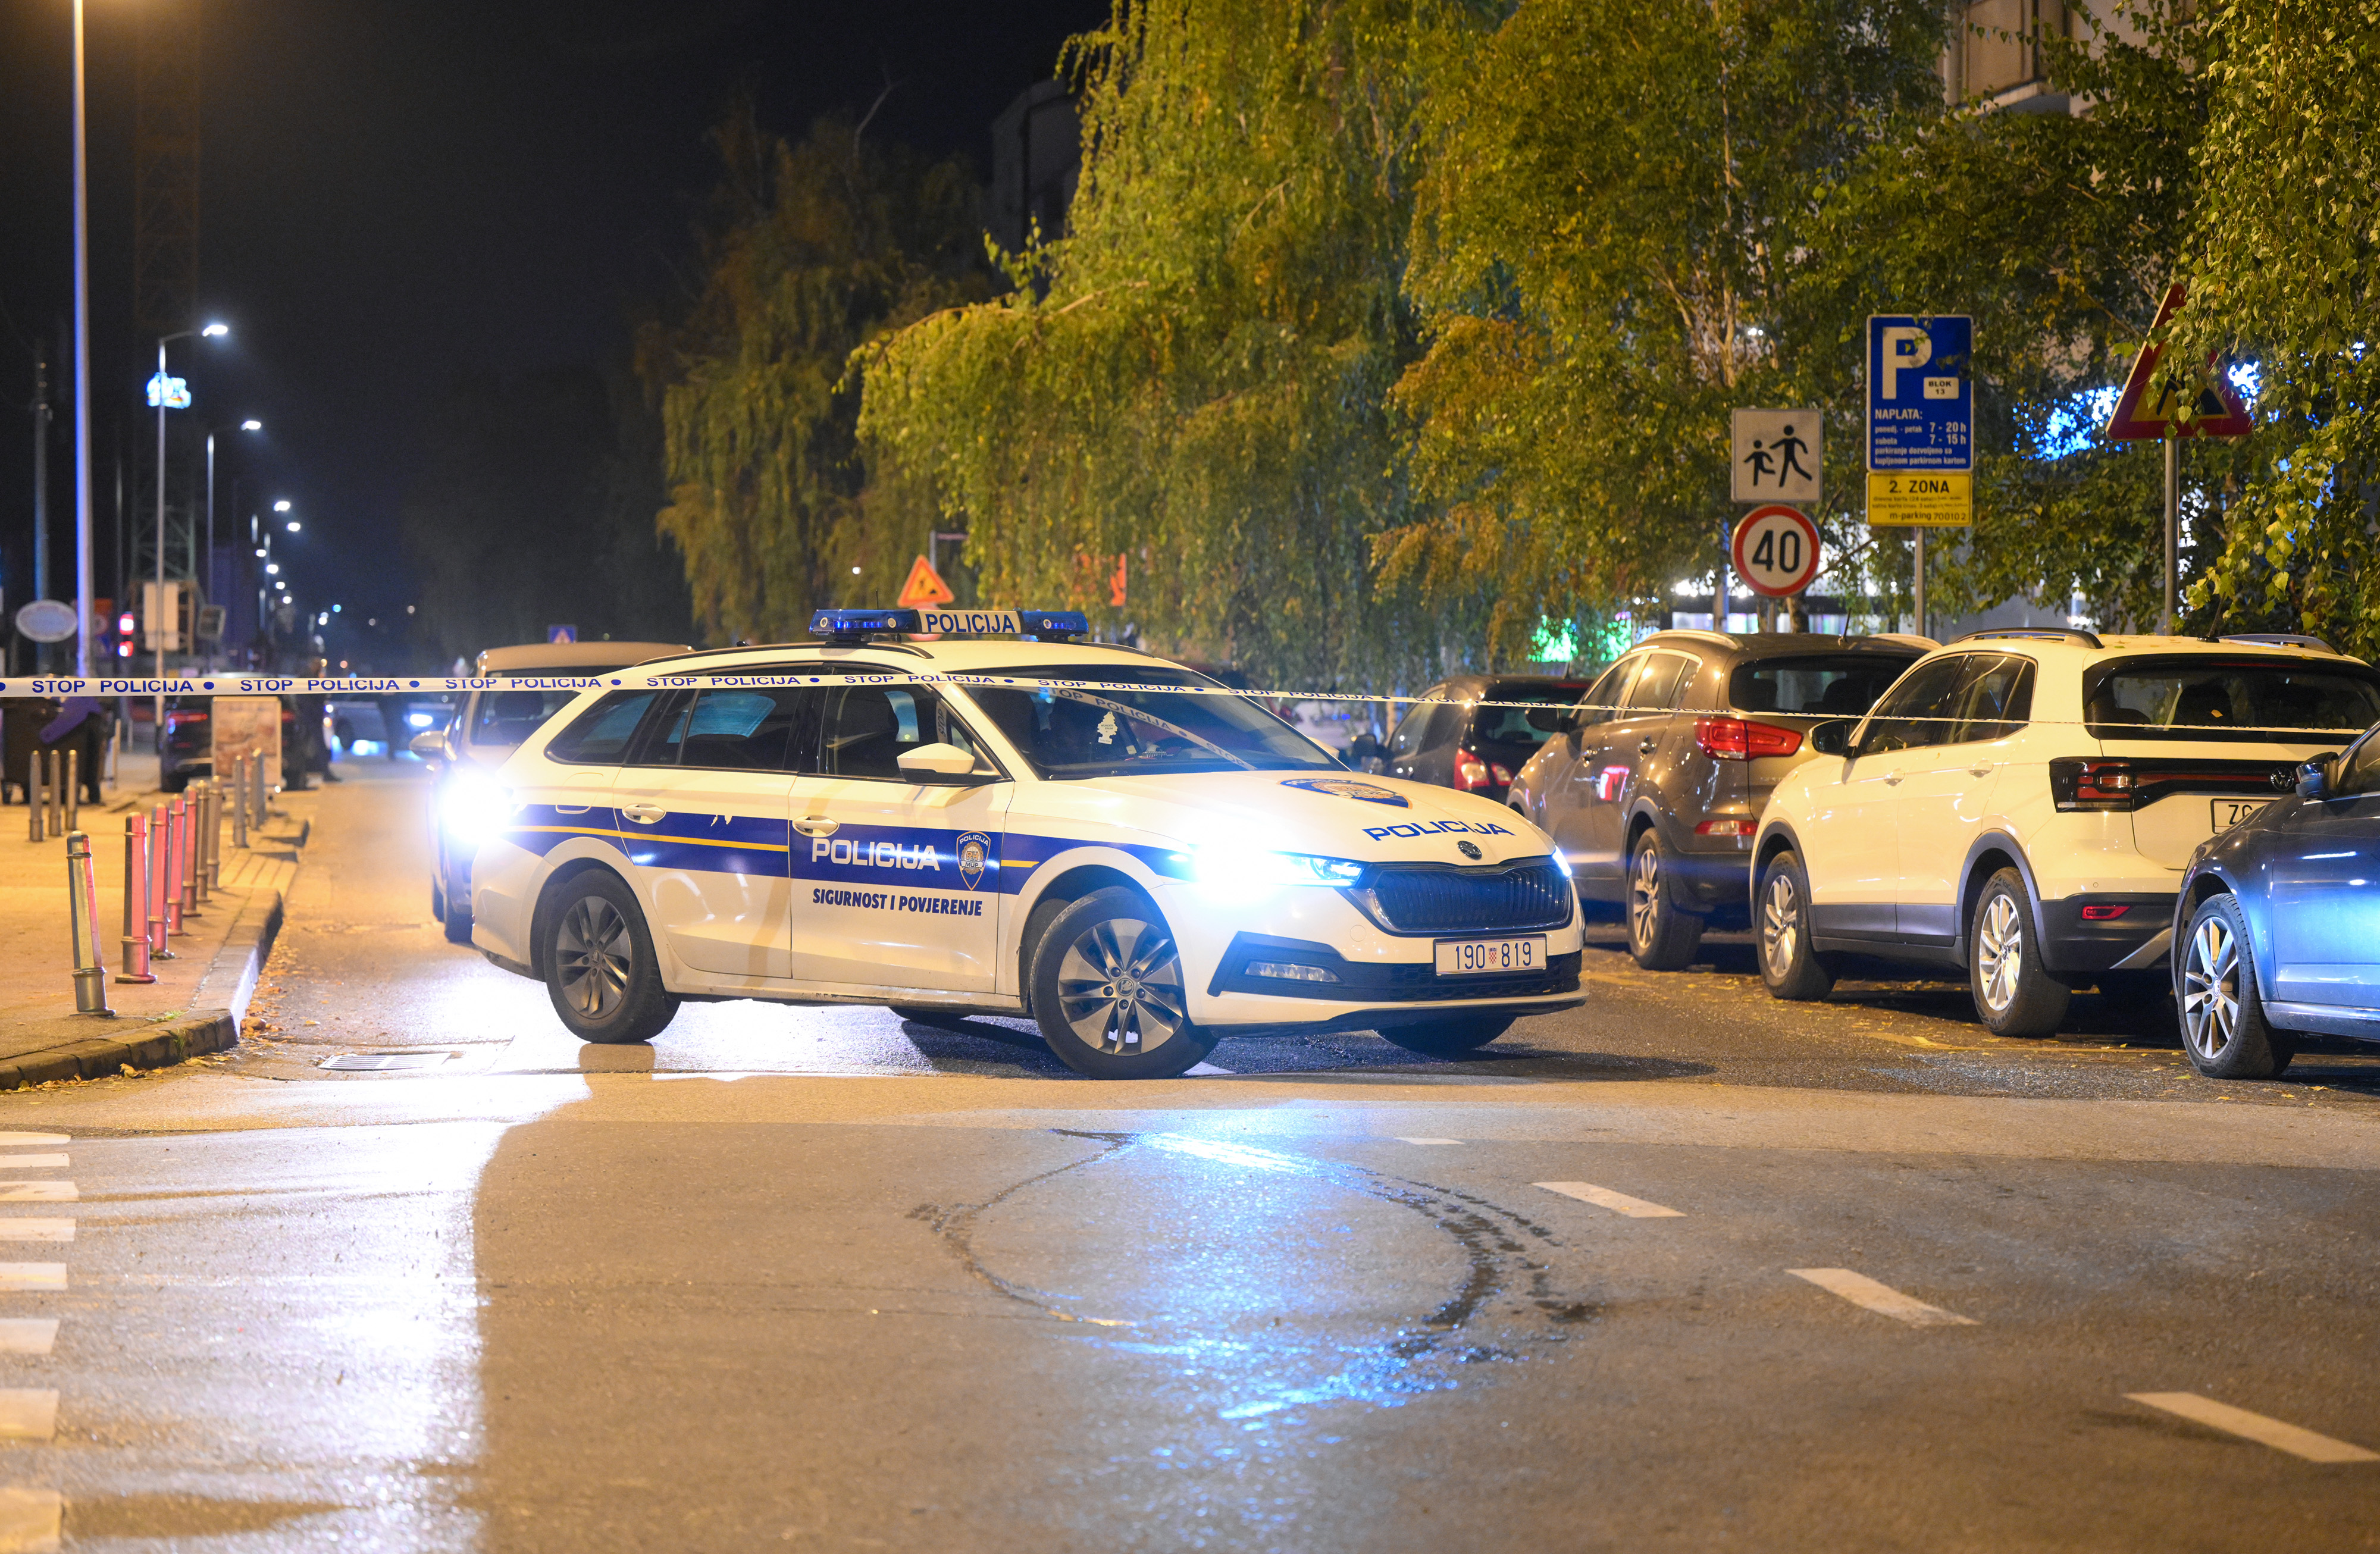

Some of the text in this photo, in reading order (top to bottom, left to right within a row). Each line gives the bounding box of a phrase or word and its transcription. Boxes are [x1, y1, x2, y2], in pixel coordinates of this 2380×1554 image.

[1882, 327, 1932, 399] P
[1875, 409, 1923, 419] NAPLATA:
[1905, 425, 1923, 434] petak
[1930, 422, 1936, 433] 7
[1946, 421, 1959, 433] 20
[1960, 422, 1966, 433] h
[1930, 434, 1936, 445] 7
[1946, 434, 1959, 445] 15
[1960, 434, 1966, 445] h
[1889, 480, 1950, 493] 2. ZONA
[1889, 512, 1932, 521] m-parking
[1752, 529, 1800, 573] 40
[926, 613, 1016, 634] POLICIJA
[32, 680, 86, 693] STOP
[100, 680, 194, 693] POLICIJA
[240, 679, 293, 691] STOP
[308, 679, 400, 691] POLICIJA
[446, 679, 497, 689] STOP
[512, 678, 602, 688] POLICIJA
[647, 678, 697, 687] STOP
[711, 677, 801, 686] POLICIJA
[844, 675, 894, 684] STOP
[908, 675, 995, 684] POLICIJA
[1100, 682, 1186, 692] POLICIJA
[1095, 698, 1172, 731] POLICIJA
[1361, 820, 1517, 841] POLICIJA
[959, 835, 988, 846] POLICIJA
[812, 838, 940, 871] POLICIJA
[966, 851, 979, 861] RH
[813, 888, 983, 916] SIGURNOST I POVJERENJE
[1456, 942, 1532, 970] 190 819
